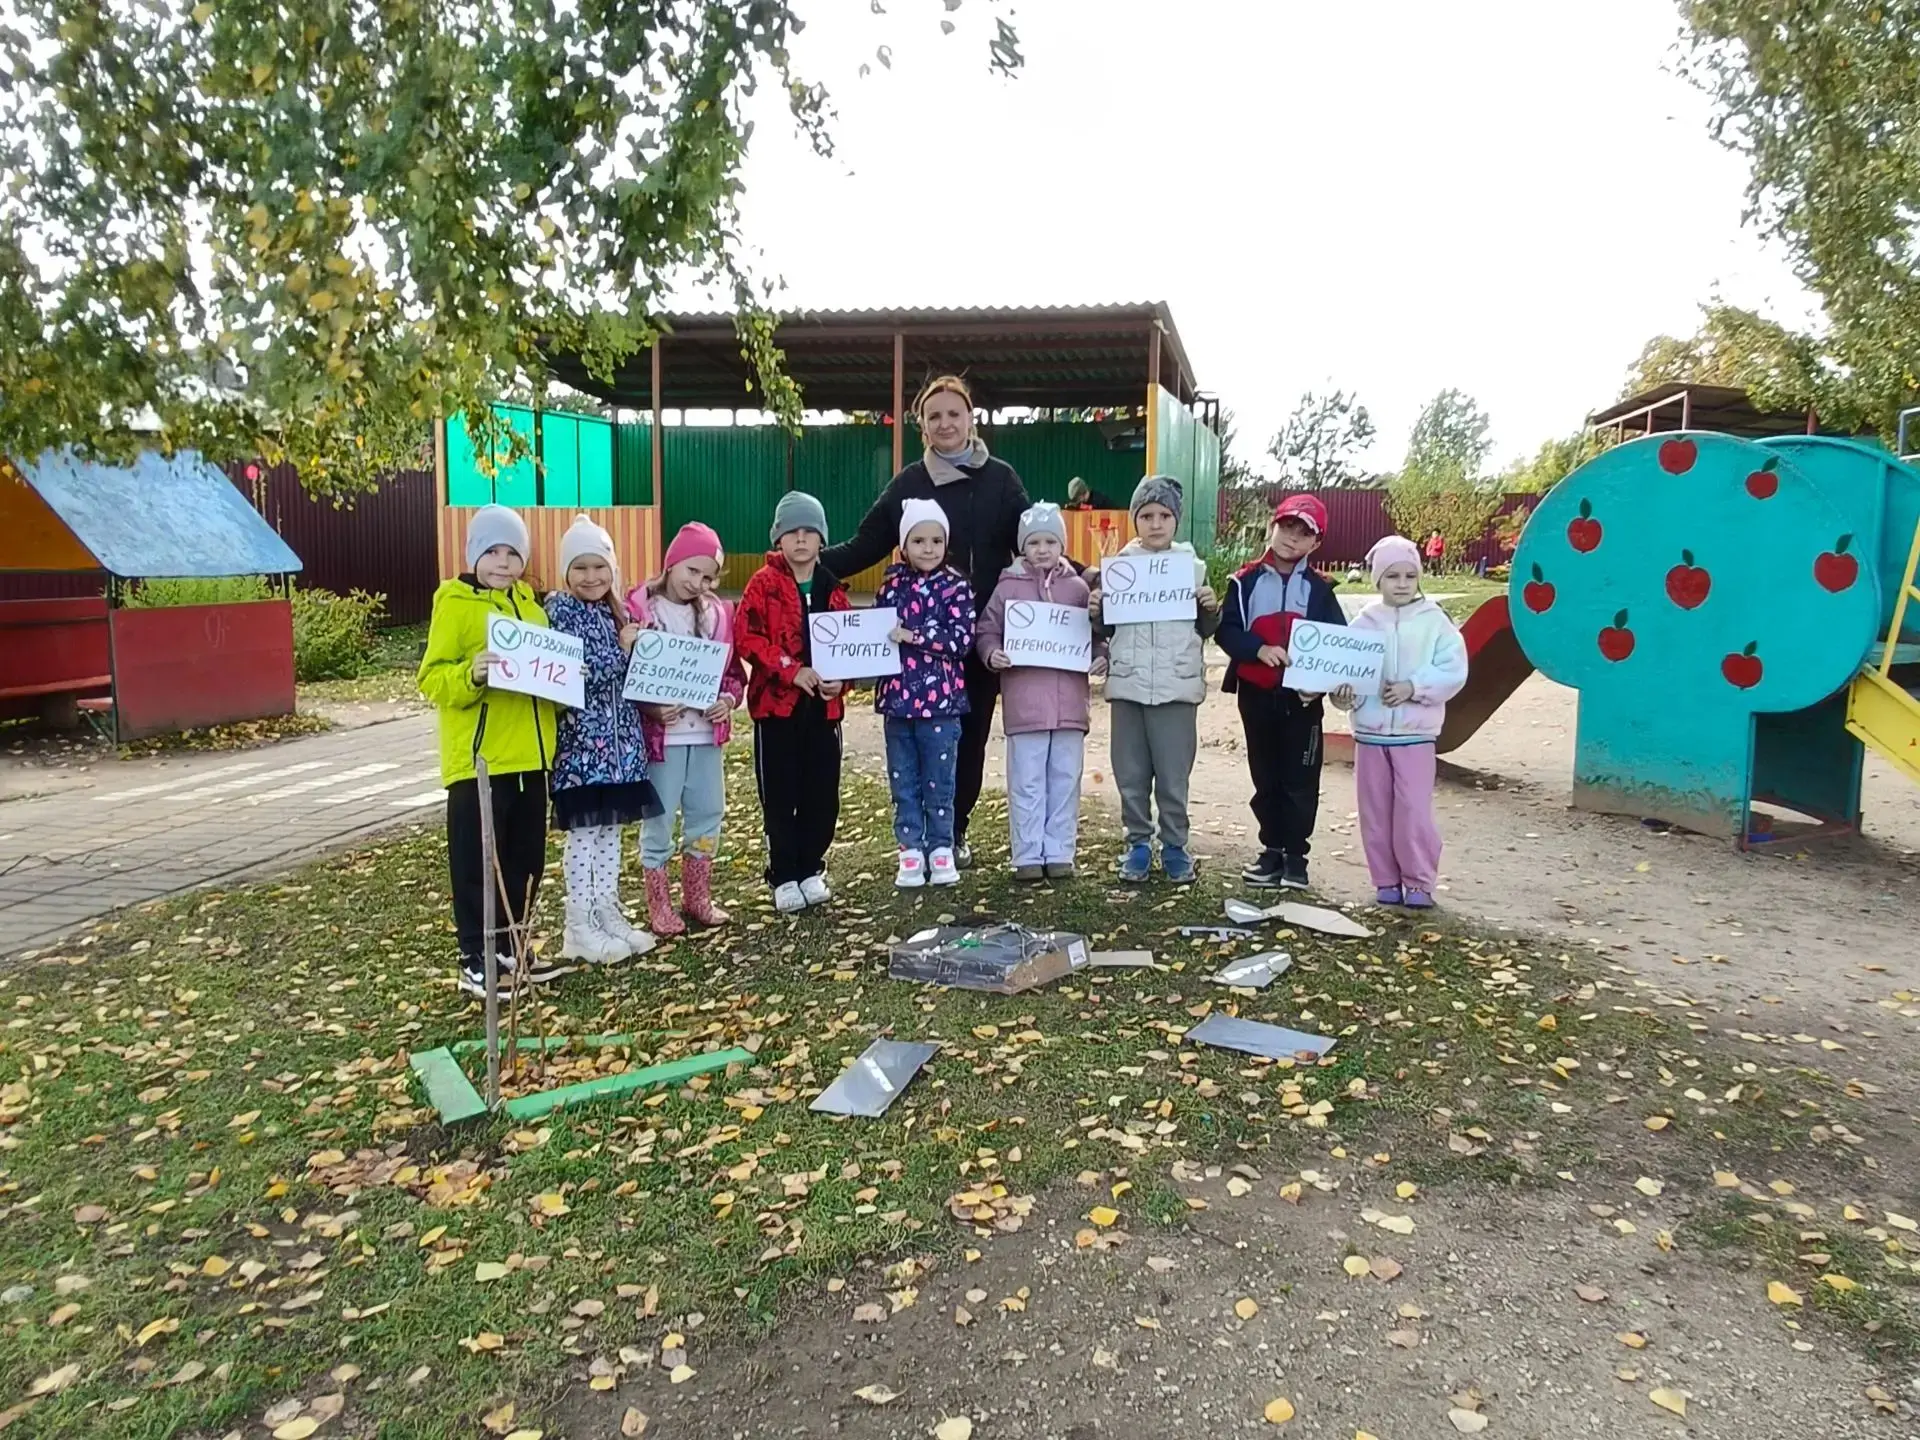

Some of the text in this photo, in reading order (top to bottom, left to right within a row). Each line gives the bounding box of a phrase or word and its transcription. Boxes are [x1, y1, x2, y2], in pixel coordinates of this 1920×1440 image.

[1149, 558, 1169, 575] НЕ
[1110, 587, 1195, 606] ОТКРЫВАТЬ
[843, 613, 860, 627] НЕ
[1049, 608, 1070, 625] НЕ
[828, 643, 891, 657] ТРОГАТЬ
[1322, 633, 1385, 654] СООБЩИТЬ
[529, 656, 566, 686] 112
[680, 656, 698, 668] НА
[1294, 655, 1376, 679] ВЗРОСЛЫМ
[630, 661, 718, 686] БЕЗОПАСНОЕ
[625, 678, 717, 704] РАССТОЯНИЕ
